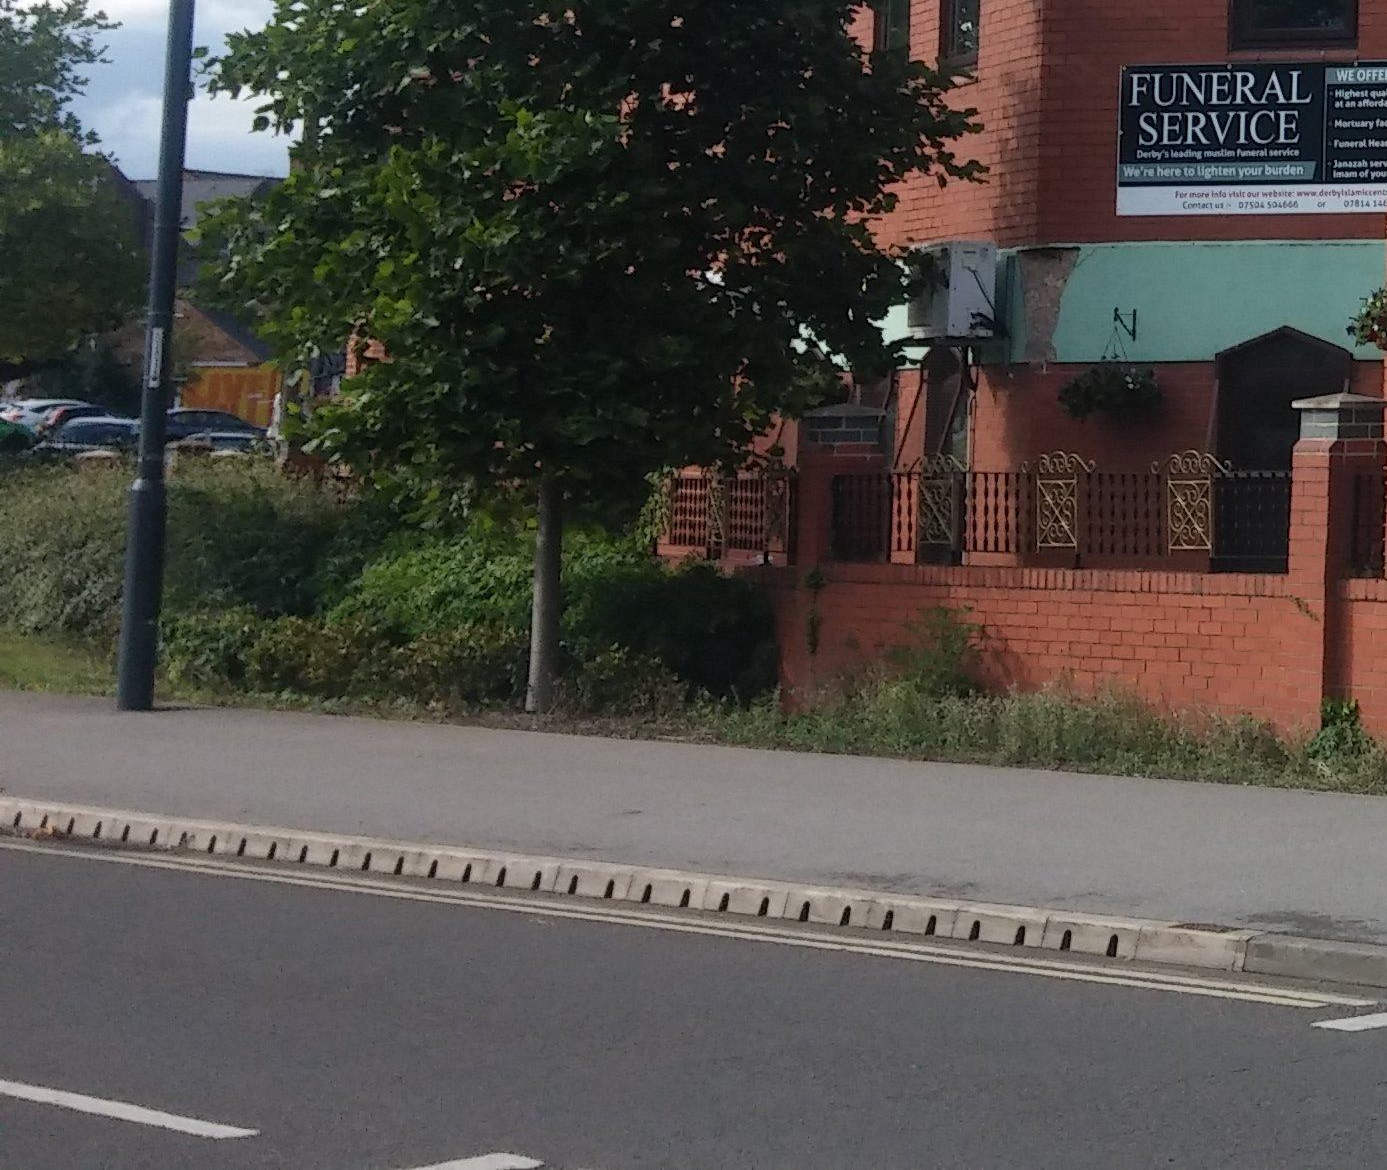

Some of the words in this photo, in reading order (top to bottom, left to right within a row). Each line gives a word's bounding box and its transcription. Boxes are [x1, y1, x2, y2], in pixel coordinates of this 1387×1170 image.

[1336, 69, 1354, 82] WE
[1128, 70, 1312, 107] FUNERAL
[1334, 88, 1369, 99] Highest
[1334, 100, 1344, 108] at
[1345, 100, 1356, 108] an
[1138, 110, 1300, 146] SERVICE
[1334, 119, 1374, 130] Mortuary
[1333, 138, 1367, 148] Funeral
[1136, 149, 1169, 160] Derby's
[1171, 148, 1201, 160] leading
[1203, 148, 1236, 158] muslim
[1236, 148, 1268, 158] funeral
[1269, 148, 1300, 157] service
[1332, 159, 1368, 169] Janazah
[1123, 166, 1155, 177] We're
[1156, 165, 1181, 177] here
[1183, 166, 1196, 177] to
[1197, 165, 1236, 179] lighten
[1238, 166, 1263, 179] your
[1265, 164, 1304, 176] burden
[1359, 169, 1369, 178] of
[1174, 190, 1188, 198] For
[1189, 191, 1210, 199] more
[1211, 190, 1227, 198] info
[1228, 190, 1245, 198] visit
[1261, 189, 1296, 199] website:
[1182, 201, 1213, 210] Contact
[1343, 199, 1371, 208] 07814
